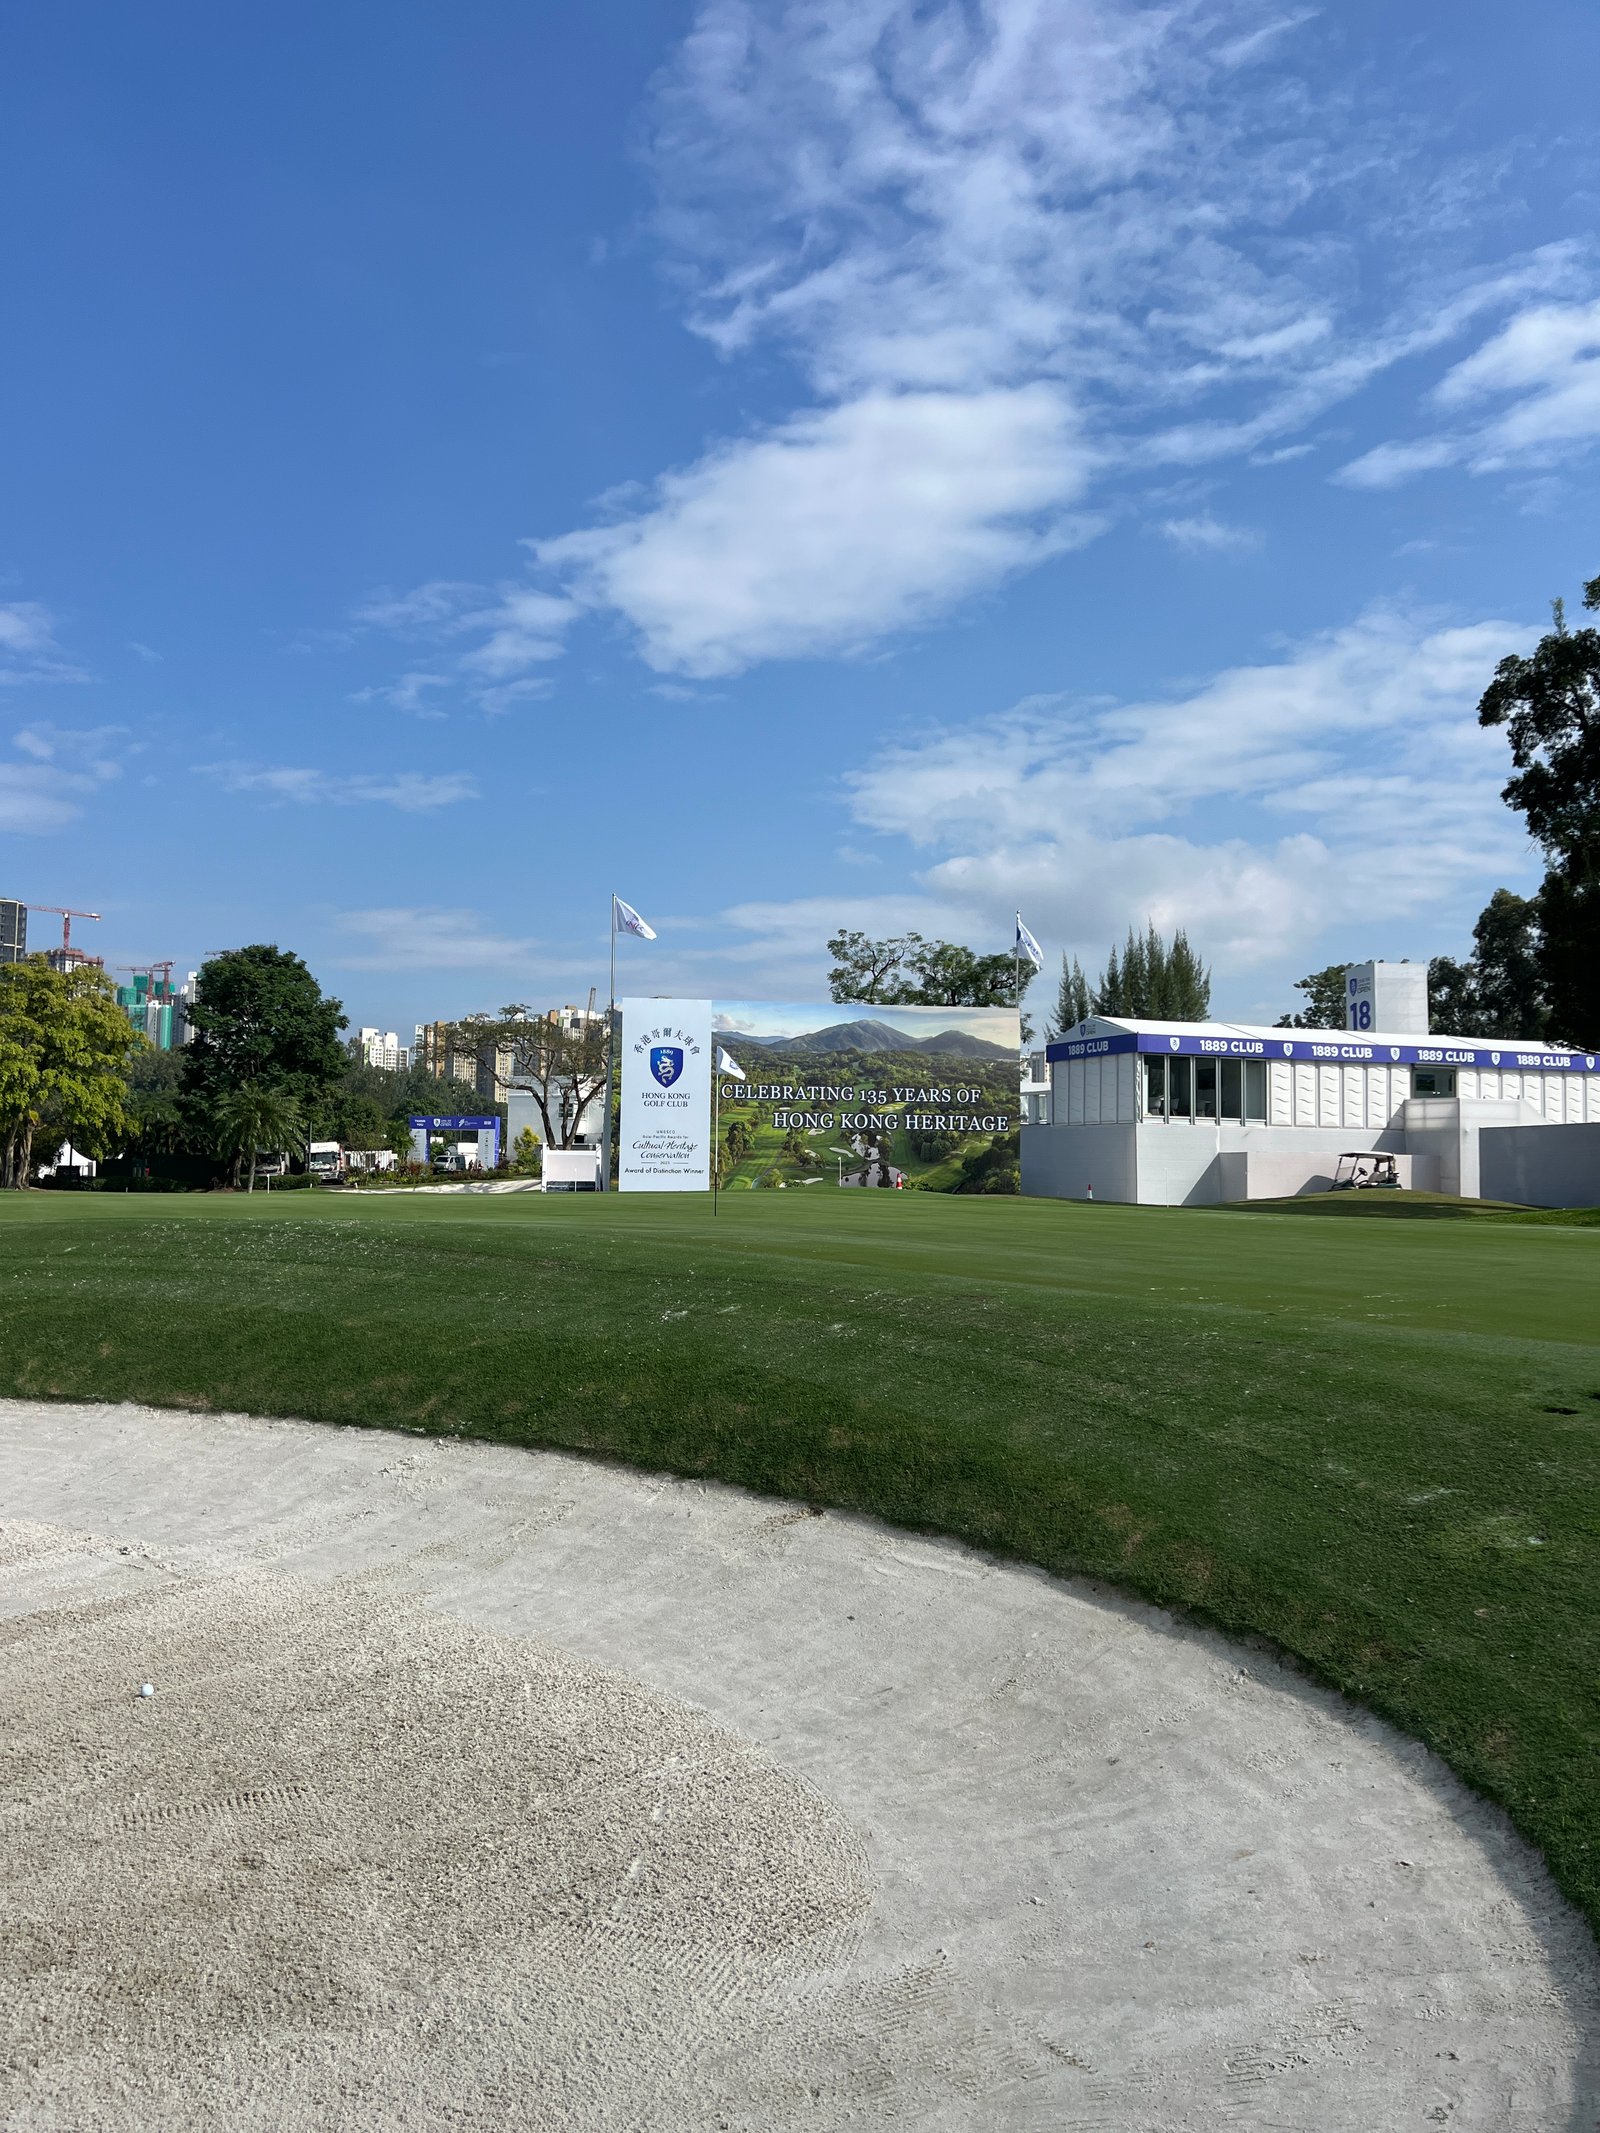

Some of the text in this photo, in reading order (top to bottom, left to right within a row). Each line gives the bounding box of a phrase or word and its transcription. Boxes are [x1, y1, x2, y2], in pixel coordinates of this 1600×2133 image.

[1350, 1000, 1371, 1031] 18
[1068, 1041, 1109, 1056] 1889 CLUB
[1199, 1039, 1264, 1054] 1889 CLUB
[1311, 1045, 1373, 1059] 1889 CLUB
[1417, 1049, 1475, 1063] 1889 CLUB
[1516, 1054, 1571, 1067] 1889 CLUB
[667, 1092, 691, 1100] KONG
[721, 1084, 982, 1105] CELEBRATING 135 YEARS OF
[643, 1100, 688, 1108] GOLF CLUB
[773, 1112, 1009, 1132] HONG KONG HERITAGE
[632, 1140, 699, 1153] Cultural Heritage
[640, 1150, 690, 1159] Conservation
